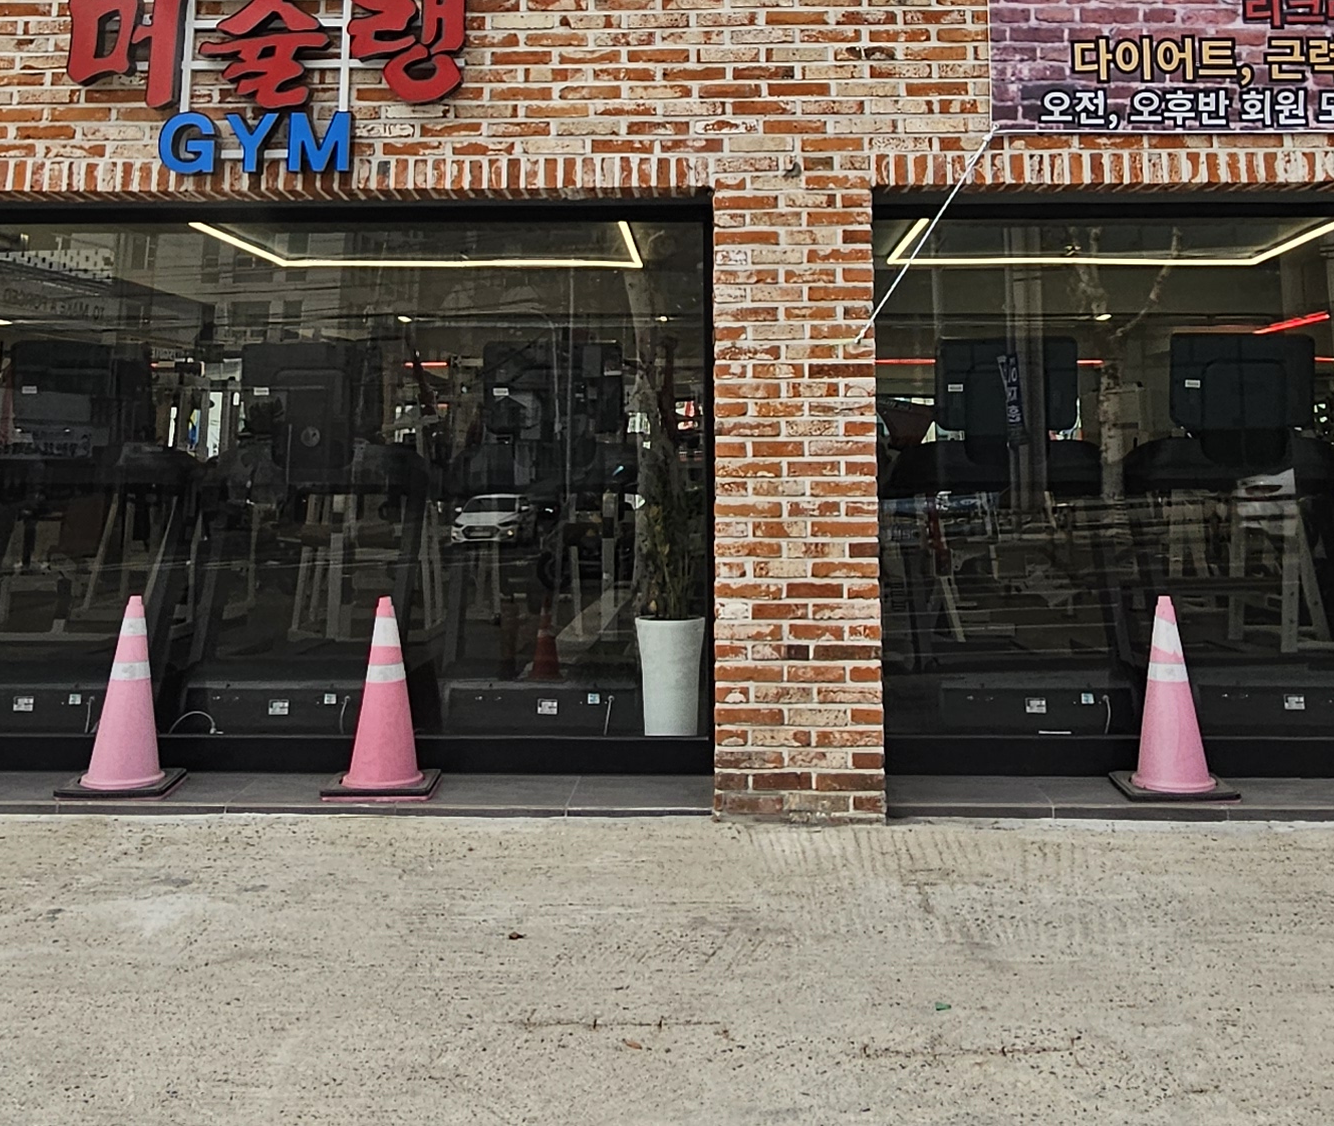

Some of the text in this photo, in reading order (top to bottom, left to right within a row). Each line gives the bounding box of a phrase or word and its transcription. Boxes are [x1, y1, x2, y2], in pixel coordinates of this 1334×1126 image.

[1072, 36, 1255, 86] 다이어트,
[1039, 91, 1123, 130] 오전,
[1128, 90, 1230, 127] 오후반
[1240, 89, 1308, 126] 회원
[158, 111, 354, 174] GYM
